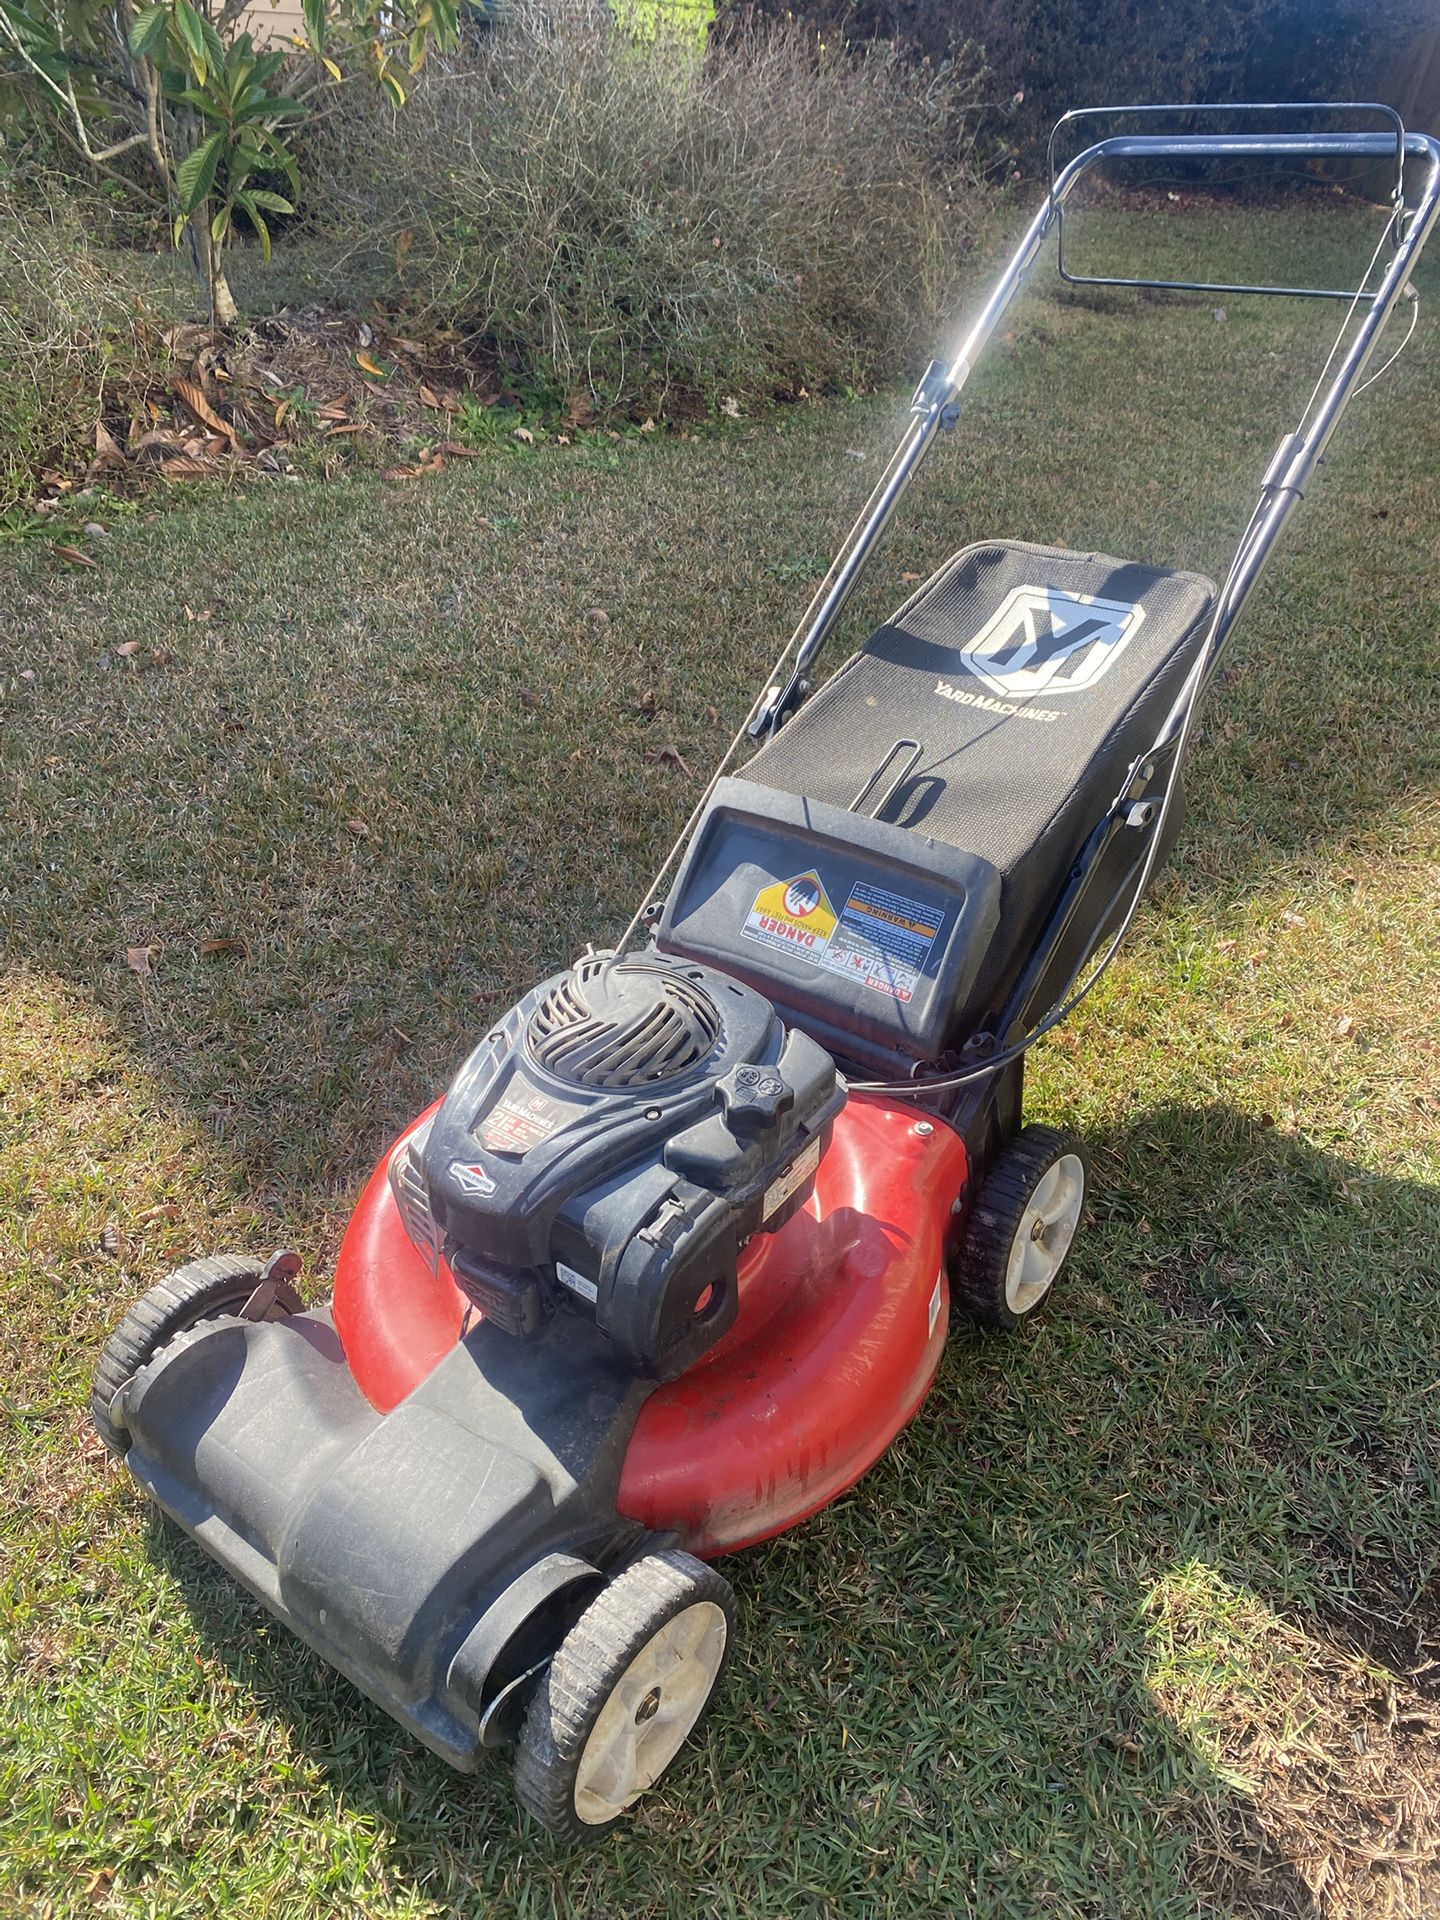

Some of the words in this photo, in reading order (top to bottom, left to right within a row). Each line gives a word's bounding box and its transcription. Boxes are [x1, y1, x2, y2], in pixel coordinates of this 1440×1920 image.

[866, 906, 906, 926] WARNING
[757, 916, 816, 948] DANGER
[867, 978, 901, 997] DANGER
